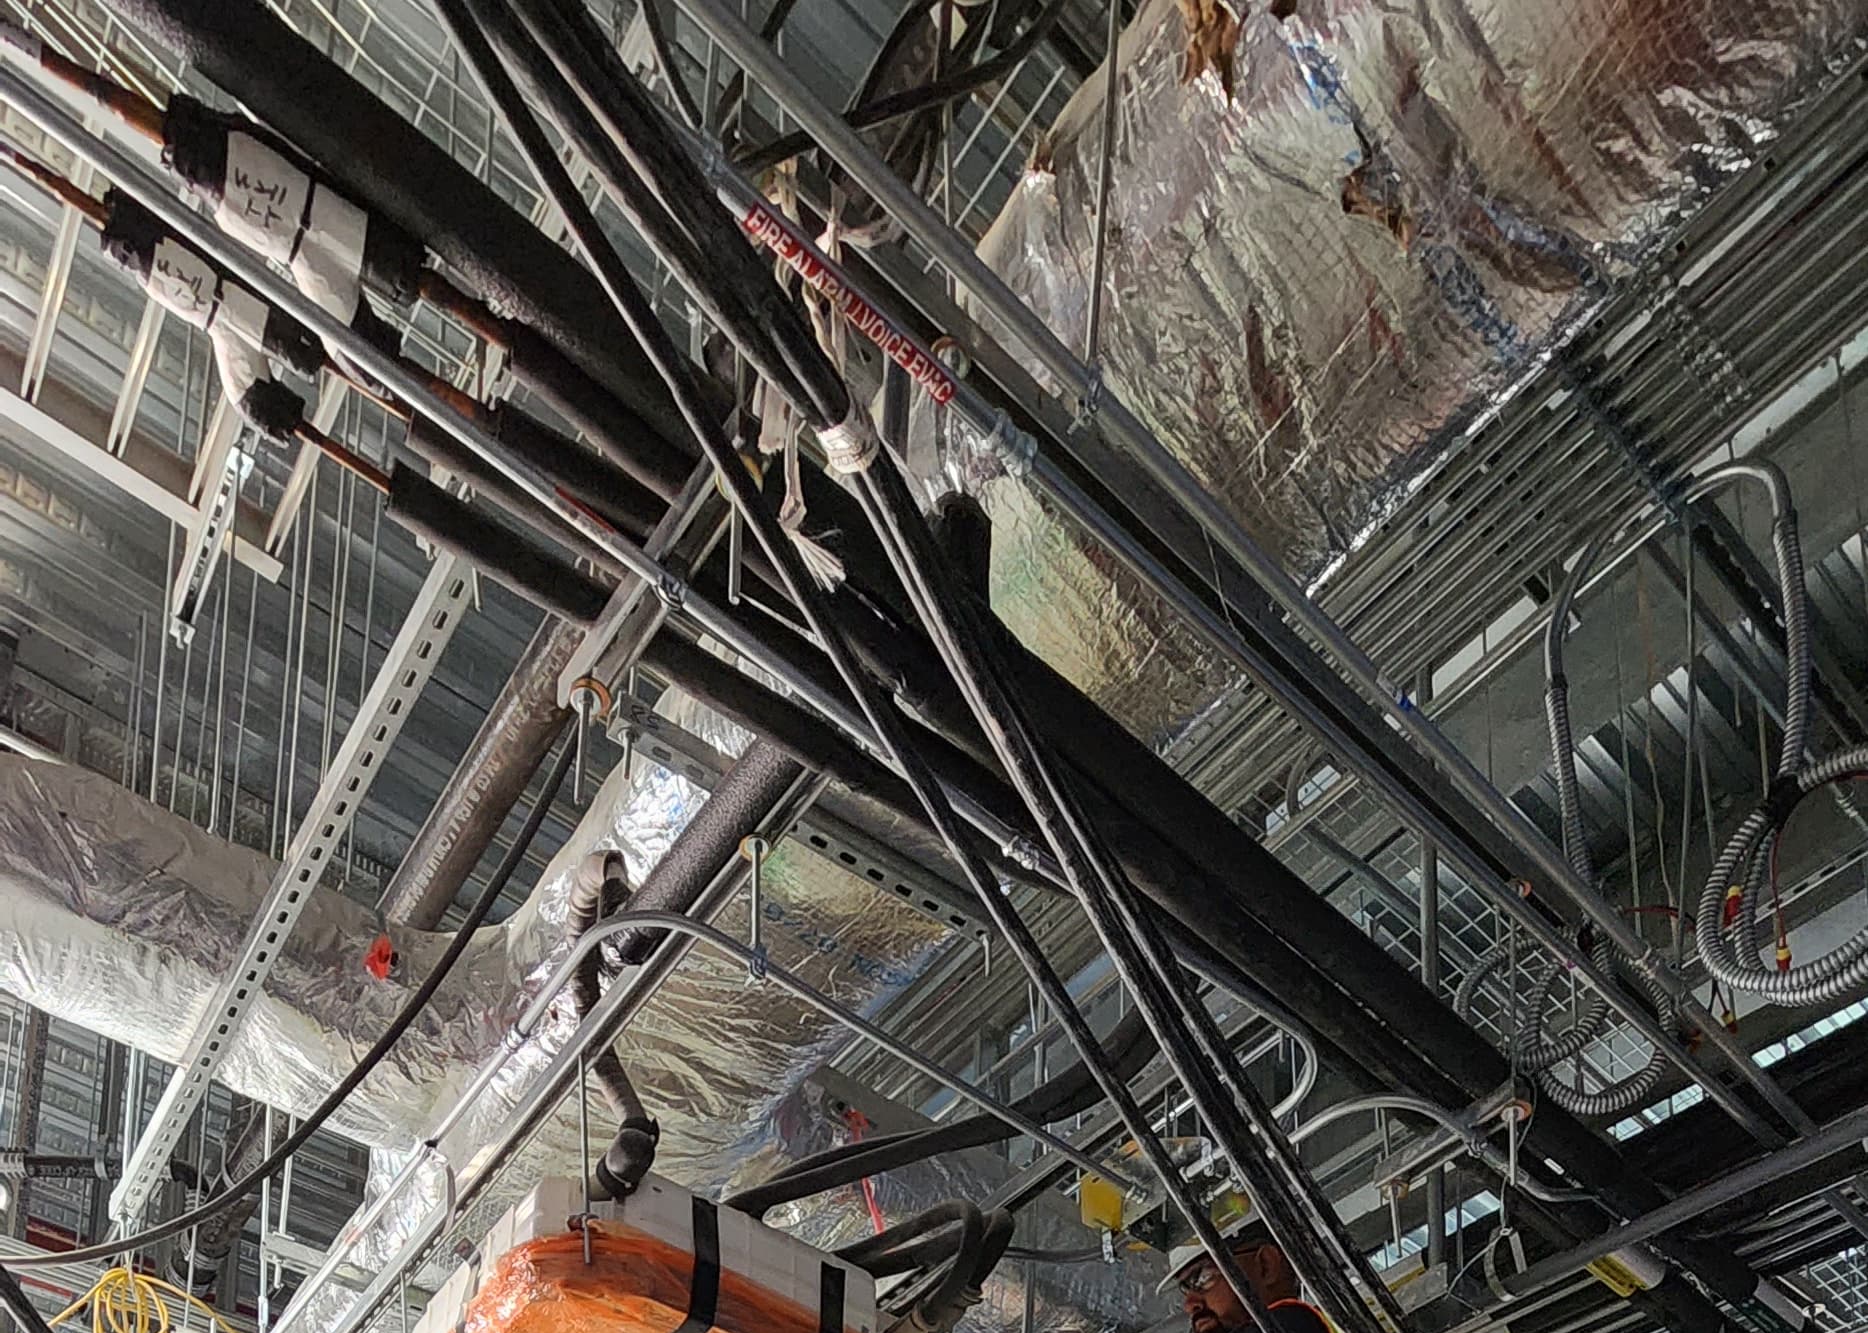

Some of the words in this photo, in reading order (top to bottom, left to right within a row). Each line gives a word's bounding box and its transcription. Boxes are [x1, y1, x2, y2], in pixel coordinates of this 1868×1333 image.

[746, 207, 794, 255] FIRE
[788, 248, 855, 313] ALARM
[857, 307, 909, 364] VOICE
[907, 354, 954, 402] EVAC
